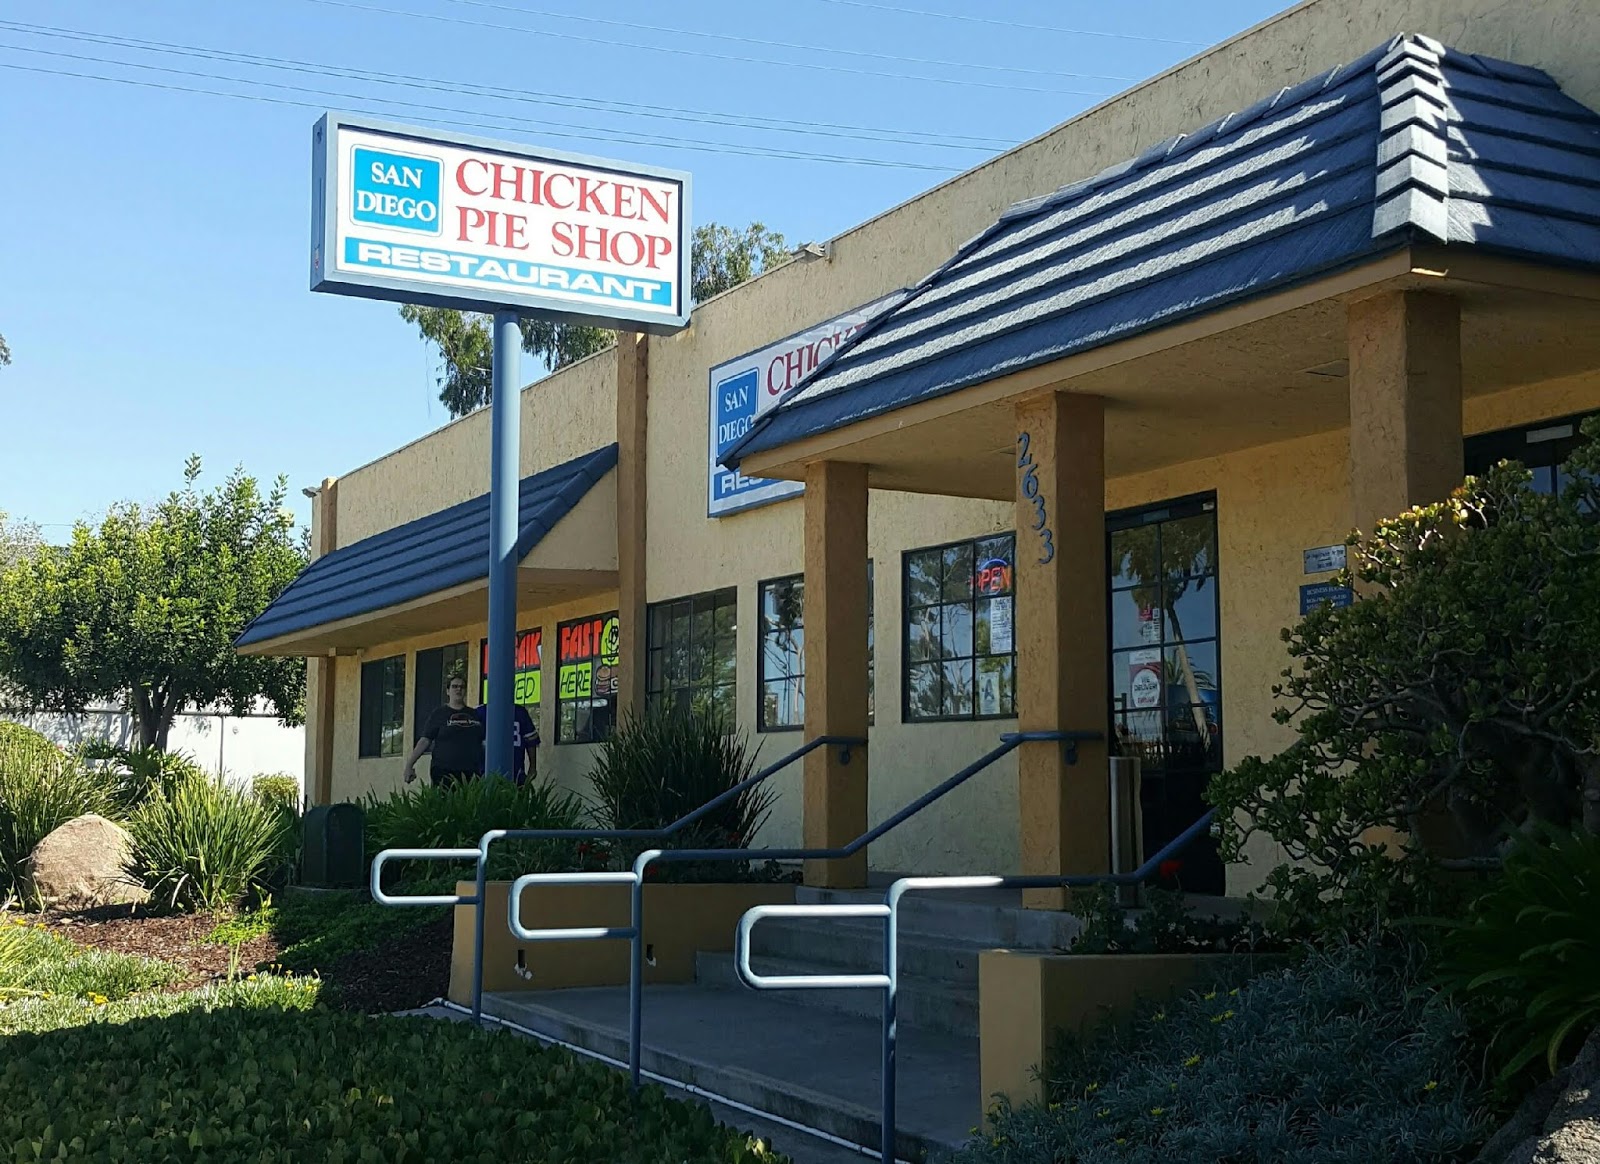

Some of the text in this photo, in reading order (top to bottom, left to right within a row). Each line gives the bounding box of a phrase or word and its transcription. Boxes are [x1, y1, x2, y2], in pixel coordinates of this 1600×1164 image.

[371, 161, 422, 190] SAN
[455, 158, 673, 224] CHICKEN
[356, 189, 437, 223] DIEGO
[455, 205, 673, 270] PIE SHOP
[358, 242, 661, 301] RESTAURANT
[724, 385, 749, 412] SAN
[1017, 432, 1055, 565] 2633
[970, 566, 1011, 592] OPEN
[560, 669, 591, 694] HERE
